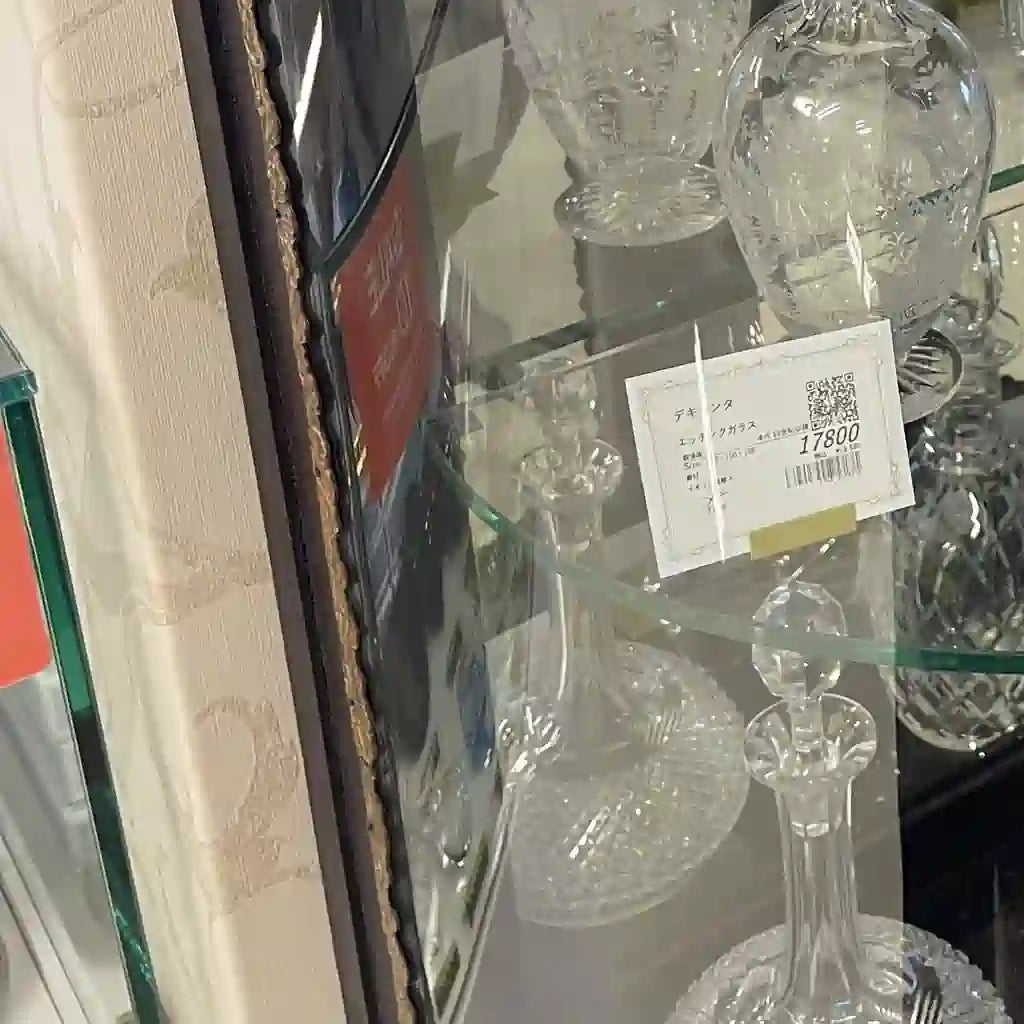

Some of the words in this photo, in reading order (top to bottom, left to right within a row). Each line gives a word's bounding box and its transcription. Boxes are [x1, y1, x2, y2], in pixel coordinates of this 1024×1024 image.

[674, 399, 733, 423] デキンタ
[799, 422, 860, 455] 17800
